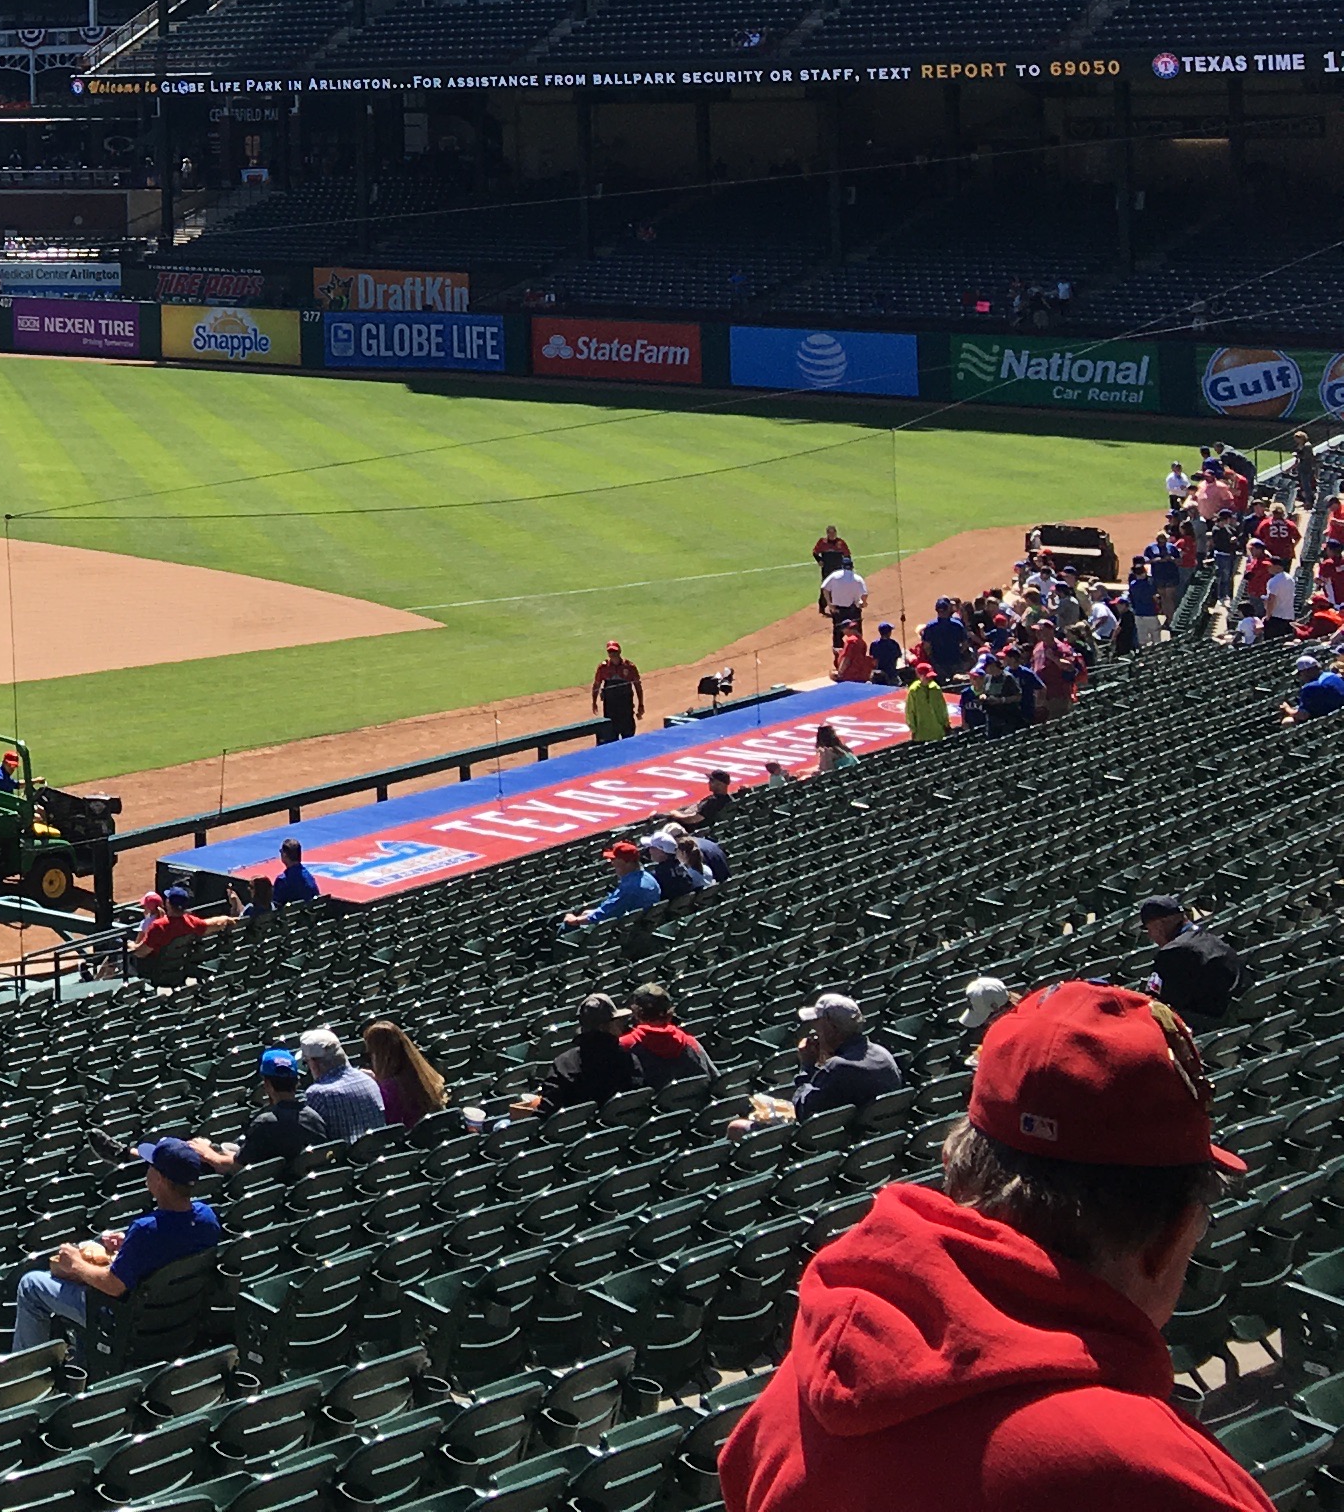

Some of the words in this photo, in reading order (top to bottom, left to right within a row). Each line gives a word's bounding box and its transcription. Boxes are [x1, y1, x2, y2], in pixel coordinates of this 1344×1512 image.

[210, 78, 242, 93] LIFE
[246, 77, 284, 93] PARK
[287, 79, 303, 91] IN
[446, 74, 539, 89] ASSISTANCE
[544, 73, 587, 87] FROM
[592, 71, 677, 86] BALLPARK
[681, 70, 764, 84] SECURITY
[769, 69, 793, 82] OR
[799, 68, 861, 84] STAFF,
[866, 66, 912, 81] TEXT
[920, 61, 1008, 80] REPORT
[1015, 63, 1041, 78] TO
[1049, 59, 1121, 78] 69050
[1181, 54, 1248, 74] TEXAS
[1253, 53, 1307, 72] TIME
[34, 268, 69, 282] Center
[70, 268, 120, 283] Arlington
[155, 271, 205, 302] TIRE
[204, 273, 266, 298] PROS
[44, 317, 95, 334] NEXEN
[98, 319, 136, 337] TIRE
[302, 310, 321, 323] 377
[193, 325, 270, 357] Snapple
[361, 322, 446, 358] GLOBE
[452, 324, 501, 361] LIFE
[999, 348, 1151, 386] National
[1052, 385, 1082, 400] Car
[1087, 386, 1145, 403] Rental
[1208, 365, 1292, 402] Gulf
[1269, 525, 1289, 538] 25
[436, 779, 688, 844] TEXAS
